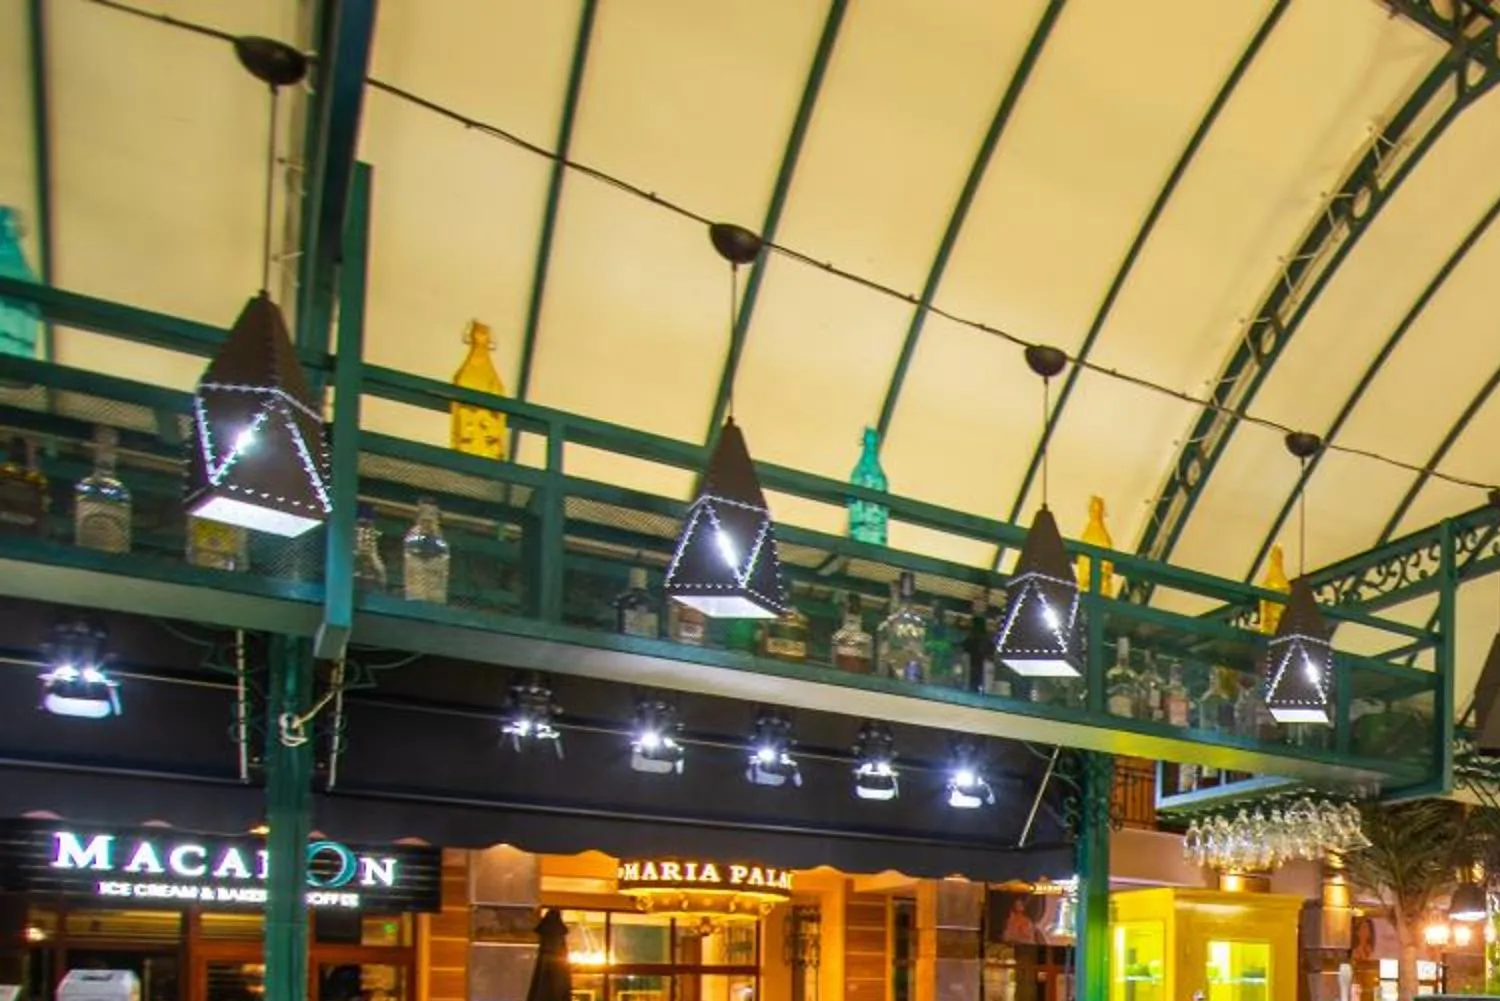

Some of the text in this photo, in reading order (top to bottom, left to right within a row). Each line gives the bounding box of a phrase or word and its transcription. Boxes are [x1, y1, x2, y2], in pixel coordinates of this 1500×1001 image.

[99, 881, 131, 896] ICE
[133, 883, 198, 899] CREAM
[200, 886, 214, 900] &
